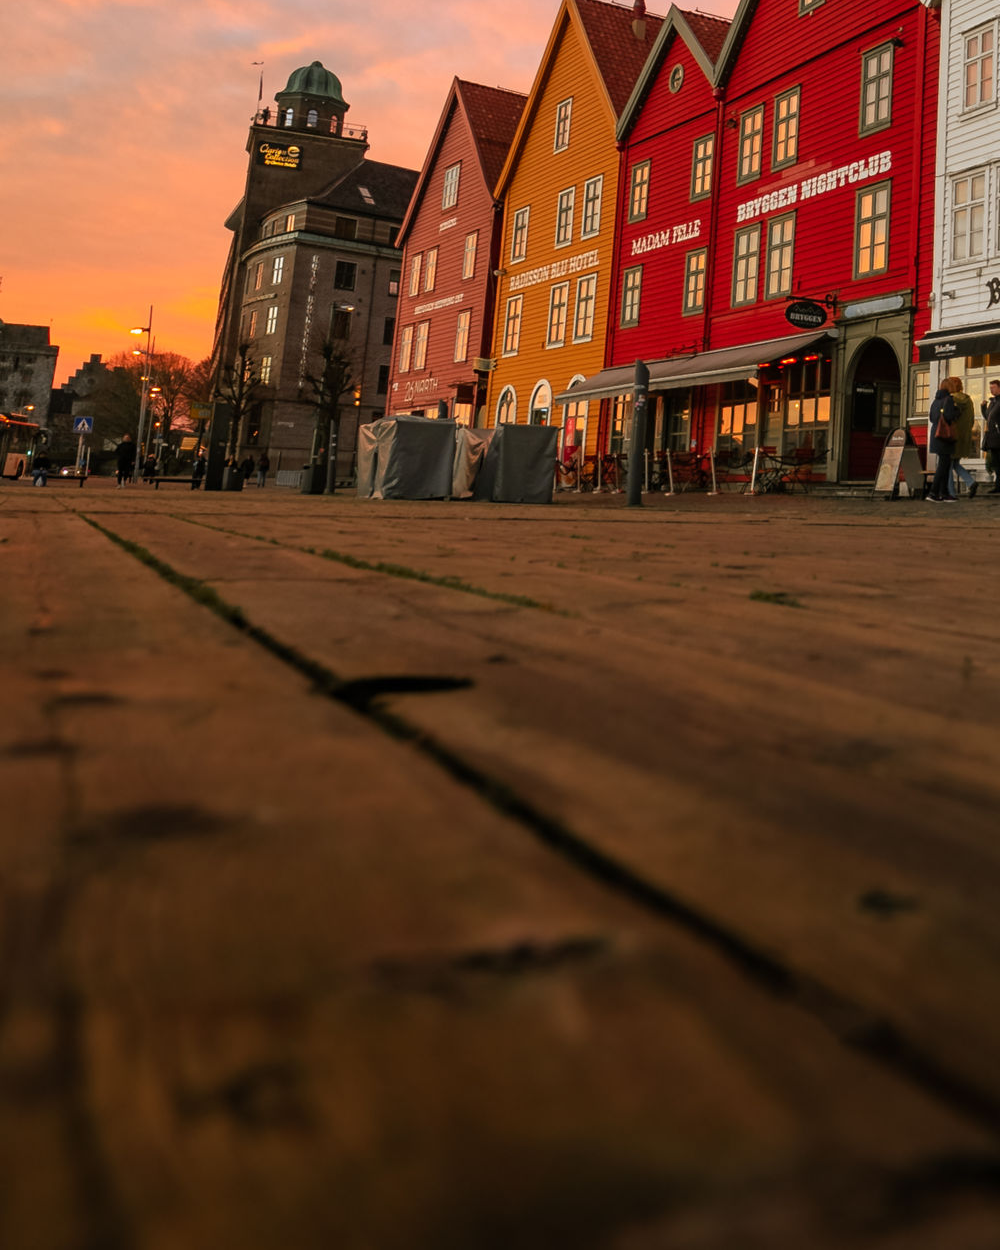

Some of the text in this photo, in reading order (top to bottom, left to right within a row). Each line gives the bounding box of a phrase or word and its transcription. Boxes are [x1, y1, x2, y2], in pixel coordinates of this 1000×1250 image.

[736, 150, 892, 223] BRYGGEN NIGHTCLUB
[630, 219, 702, 256] MADAM FELLE
[550, 258, 569, 279] BLU
[569, 249, 600, 273] HOTEL
[789, 312, 823, 323] BRYGGEN
